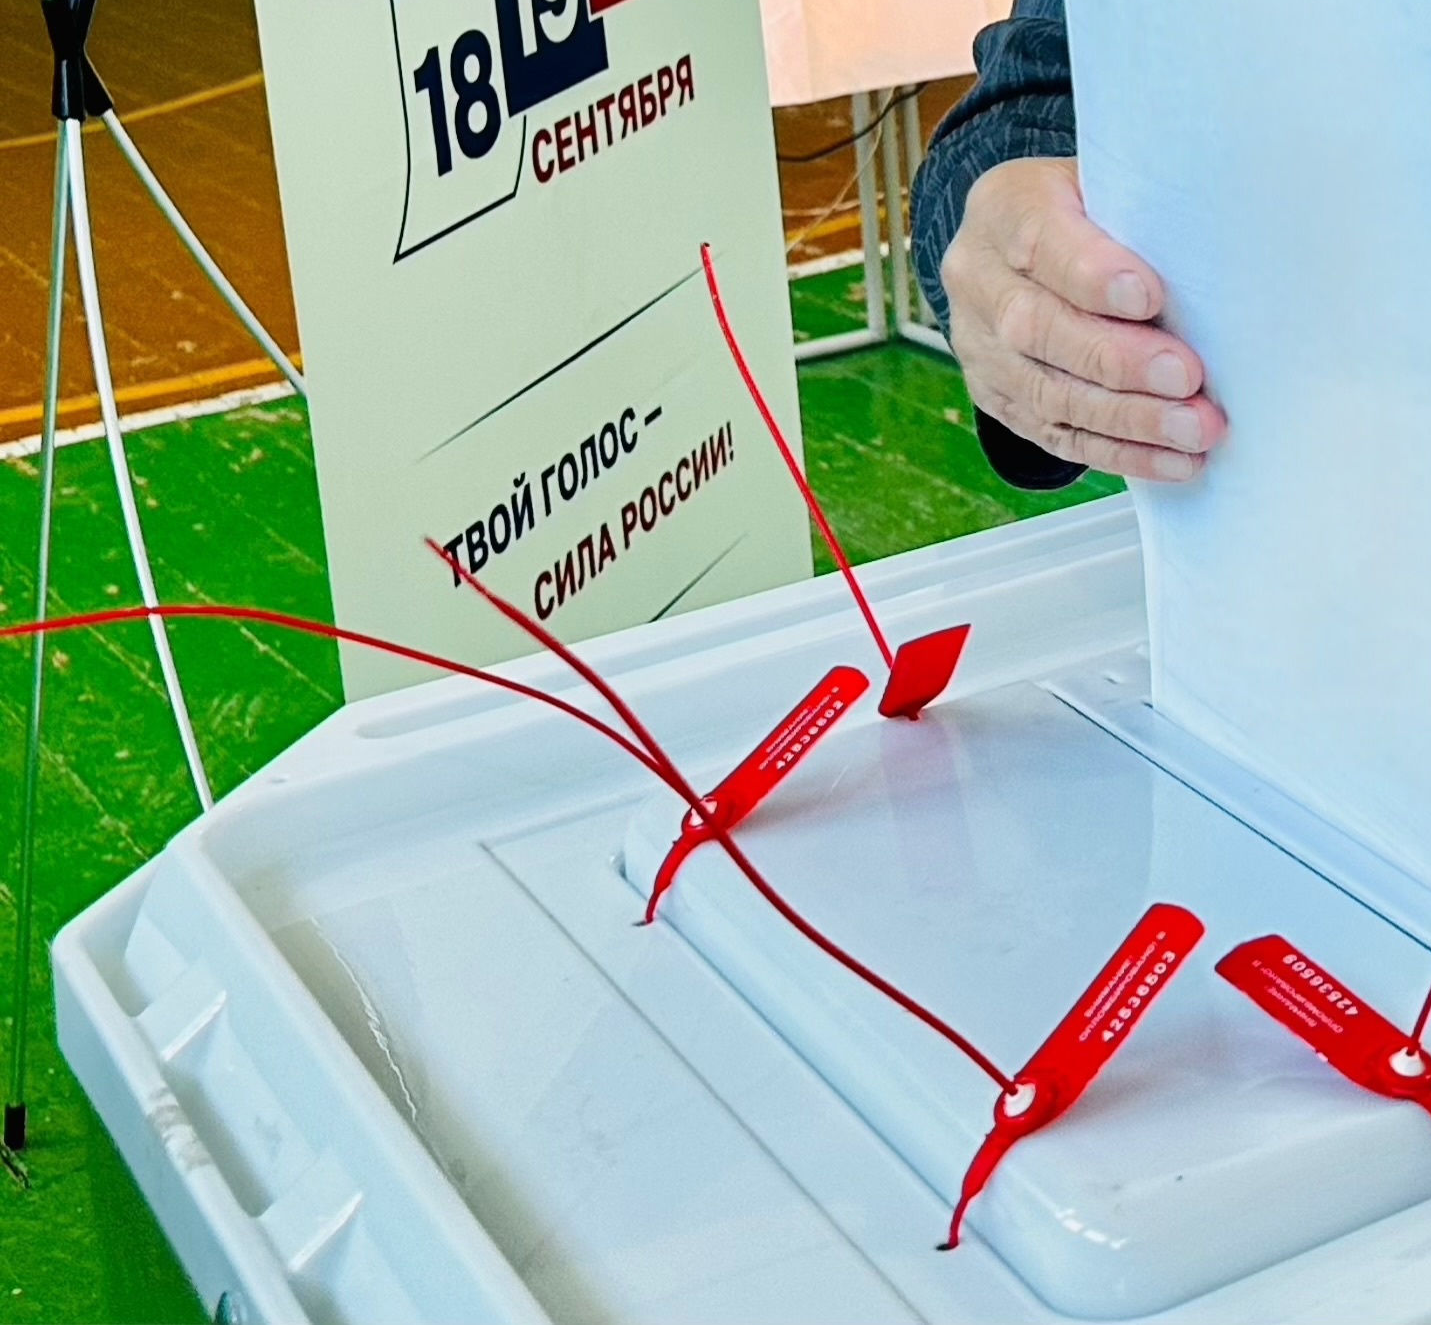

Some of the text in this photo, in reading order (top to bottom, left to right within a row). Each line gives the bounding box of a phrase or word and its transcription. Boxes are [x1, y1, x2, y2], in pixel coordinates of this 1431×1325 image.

[413, 29, 501, 177] 18
[532, 53, 695, 183] СЕНТЯБРЯ
[443, 472, 536, 588] ТВОЙ
[541, 407, 639, 517] ГОЛОС
[534, 421, 735, 621] СИЛА РОССИИ!
